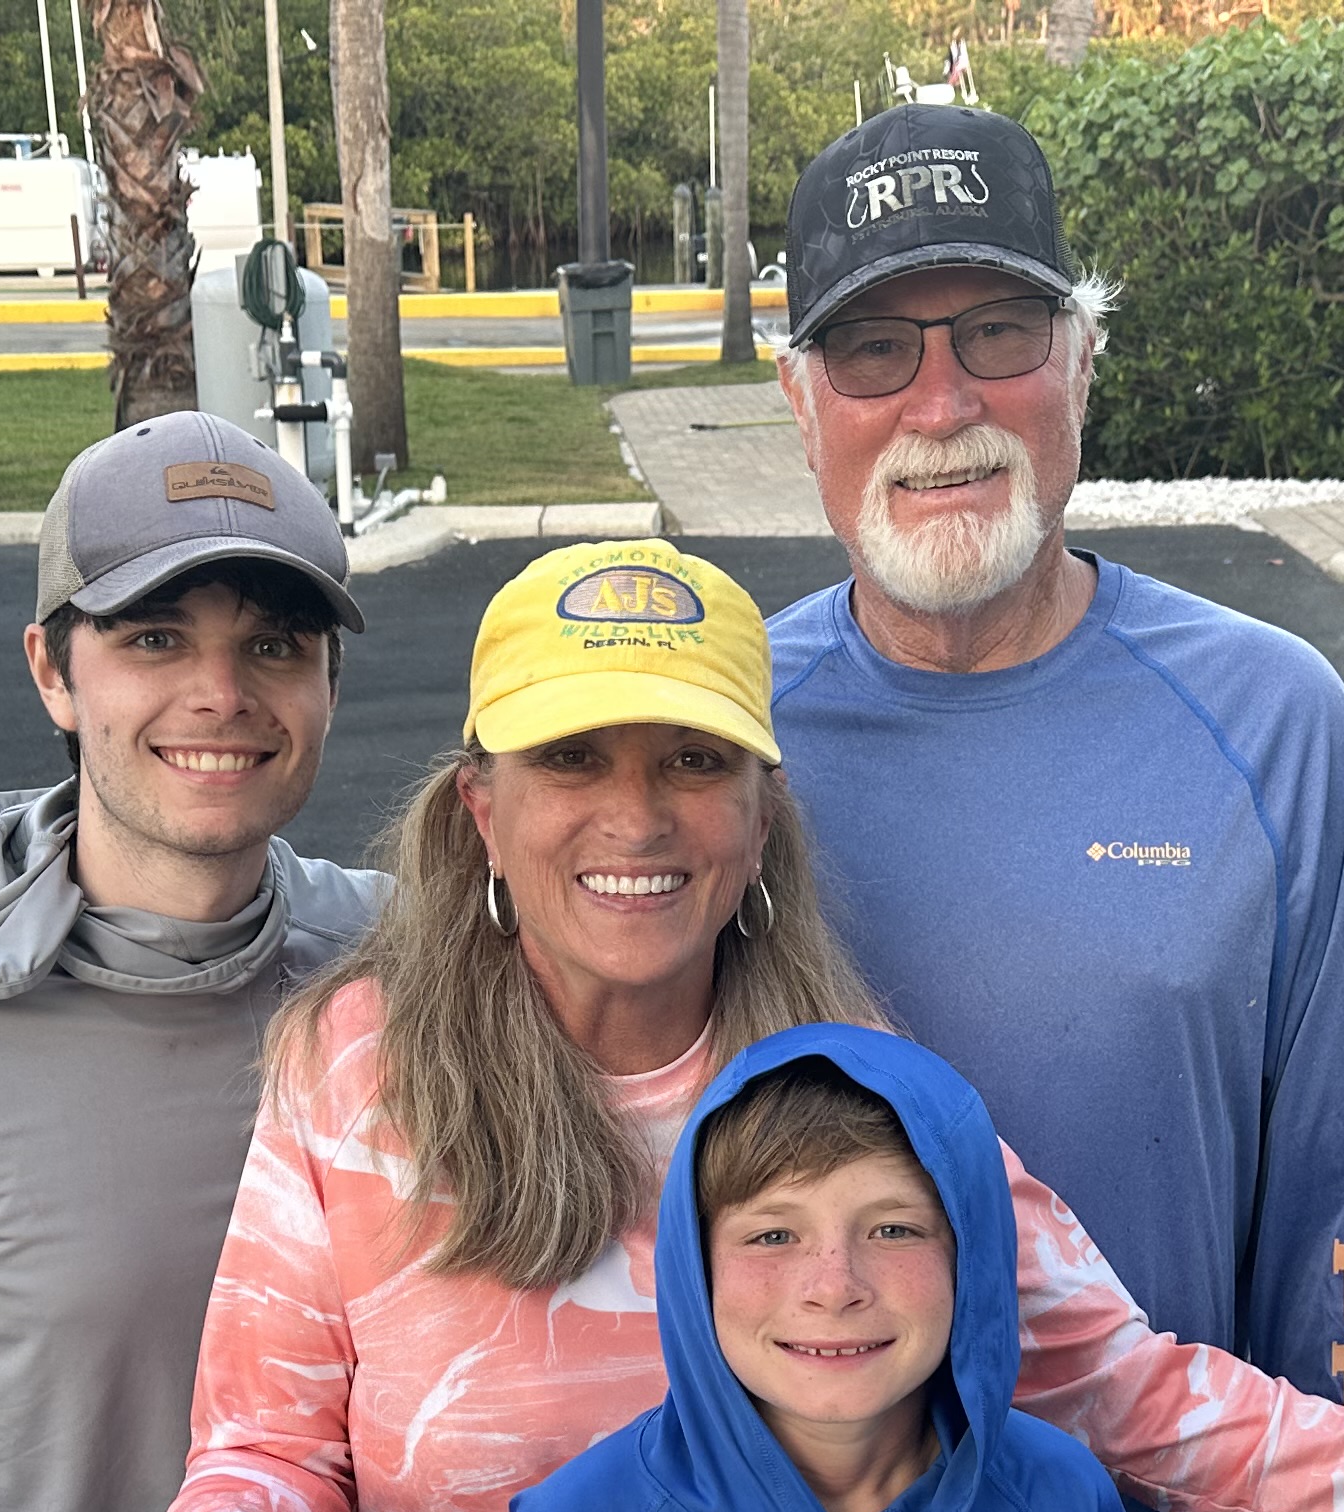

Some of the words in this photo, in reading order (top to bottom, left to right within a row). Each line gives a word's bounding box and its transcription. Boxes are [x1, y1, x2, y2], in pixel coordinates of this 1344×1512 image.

[845, 158, 889, 187] ROCKY
[888, 149, 931, 168] POINT
[932, 149, 980, 162] RESORT
[865, 164, 973, 221] RPR
[558, 550, 704, 591] PROMOTING
[1107, 841, 1191, 859] Columbia
